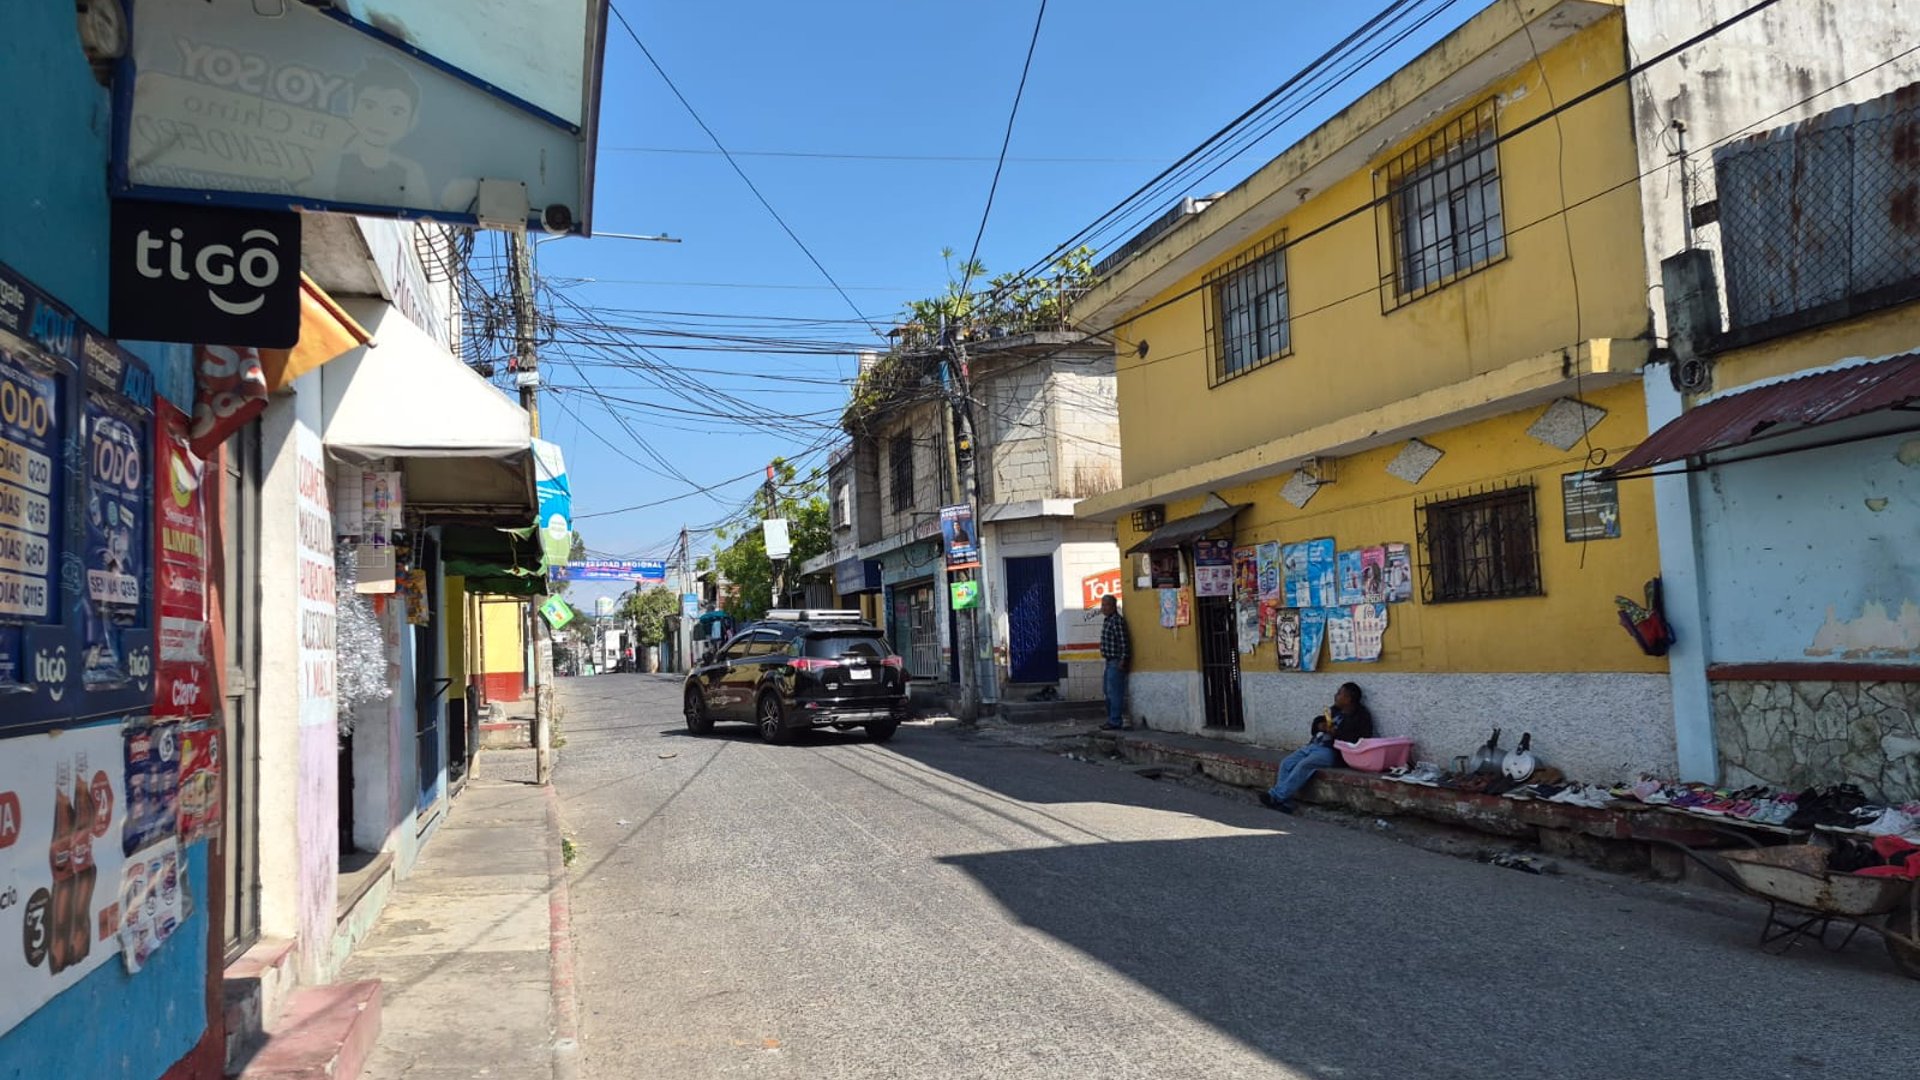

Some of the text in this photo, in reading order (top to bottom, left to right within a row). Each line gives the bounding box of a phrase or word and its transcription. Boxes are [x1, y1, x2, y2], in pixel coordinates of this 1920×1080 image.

[27, 458, 48, 484] Q20
[92, 434, 140, 490] TODO
[26, 500, 47, 525] Q35
[24, 542, 45, 567] Q60
[22, 583, 44, 609] Q115
[119, 578, 139, 600] Q35
[172, 679, 199, 707] Claro
